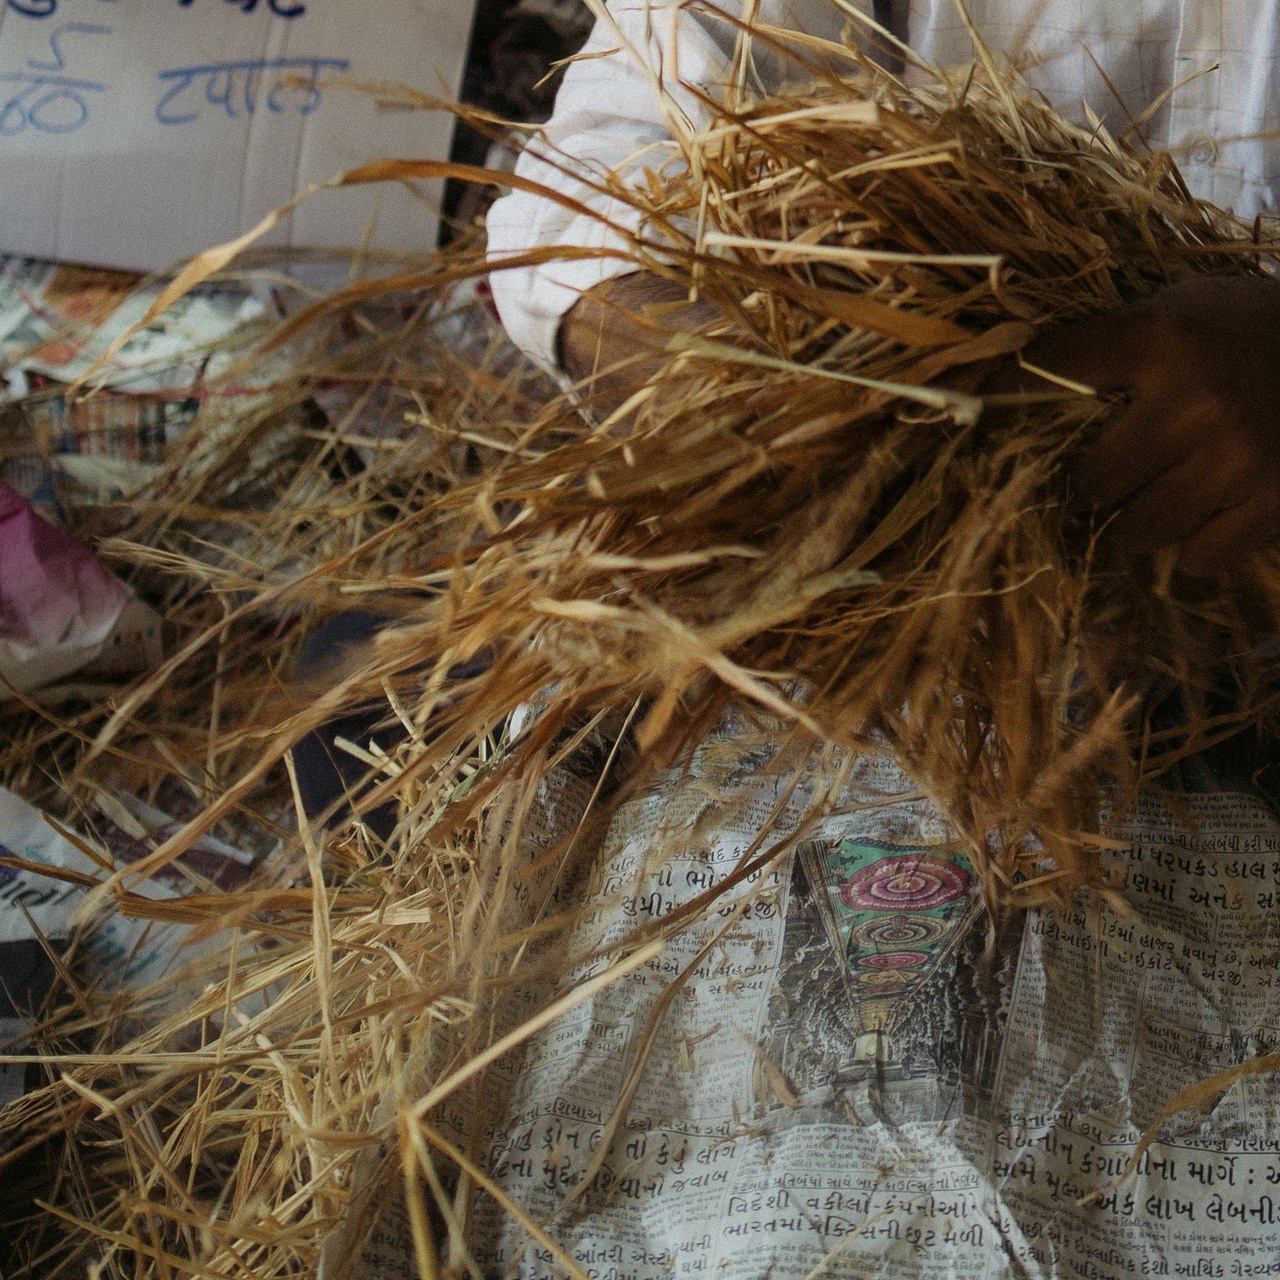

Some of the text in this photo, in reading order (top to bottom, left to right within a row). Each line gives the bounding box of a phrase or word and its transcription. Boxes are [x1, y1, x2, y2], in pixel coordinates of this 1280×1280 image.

[1150, 847, 1219, 877] ધરપકડ
[1223, 859, 1266, 880] હાલ
[1188, 883, 1244, 911] અનેક
[625, 1132, 649, 1161] તો
[670, 1170, 729, 1193] જવાબ
[1186, 1156, 1239, 1188] માર્ગે
[727, 1189, 790, 1217] વિદેશી
[1145, 1194, 1197, 1222] લાખ
[723, 1212, 803, 1238] ભારતમાં
[942, 1223, 985, 1248] મળી
[1173, 1257, 1225, 1278] આર્થિક
